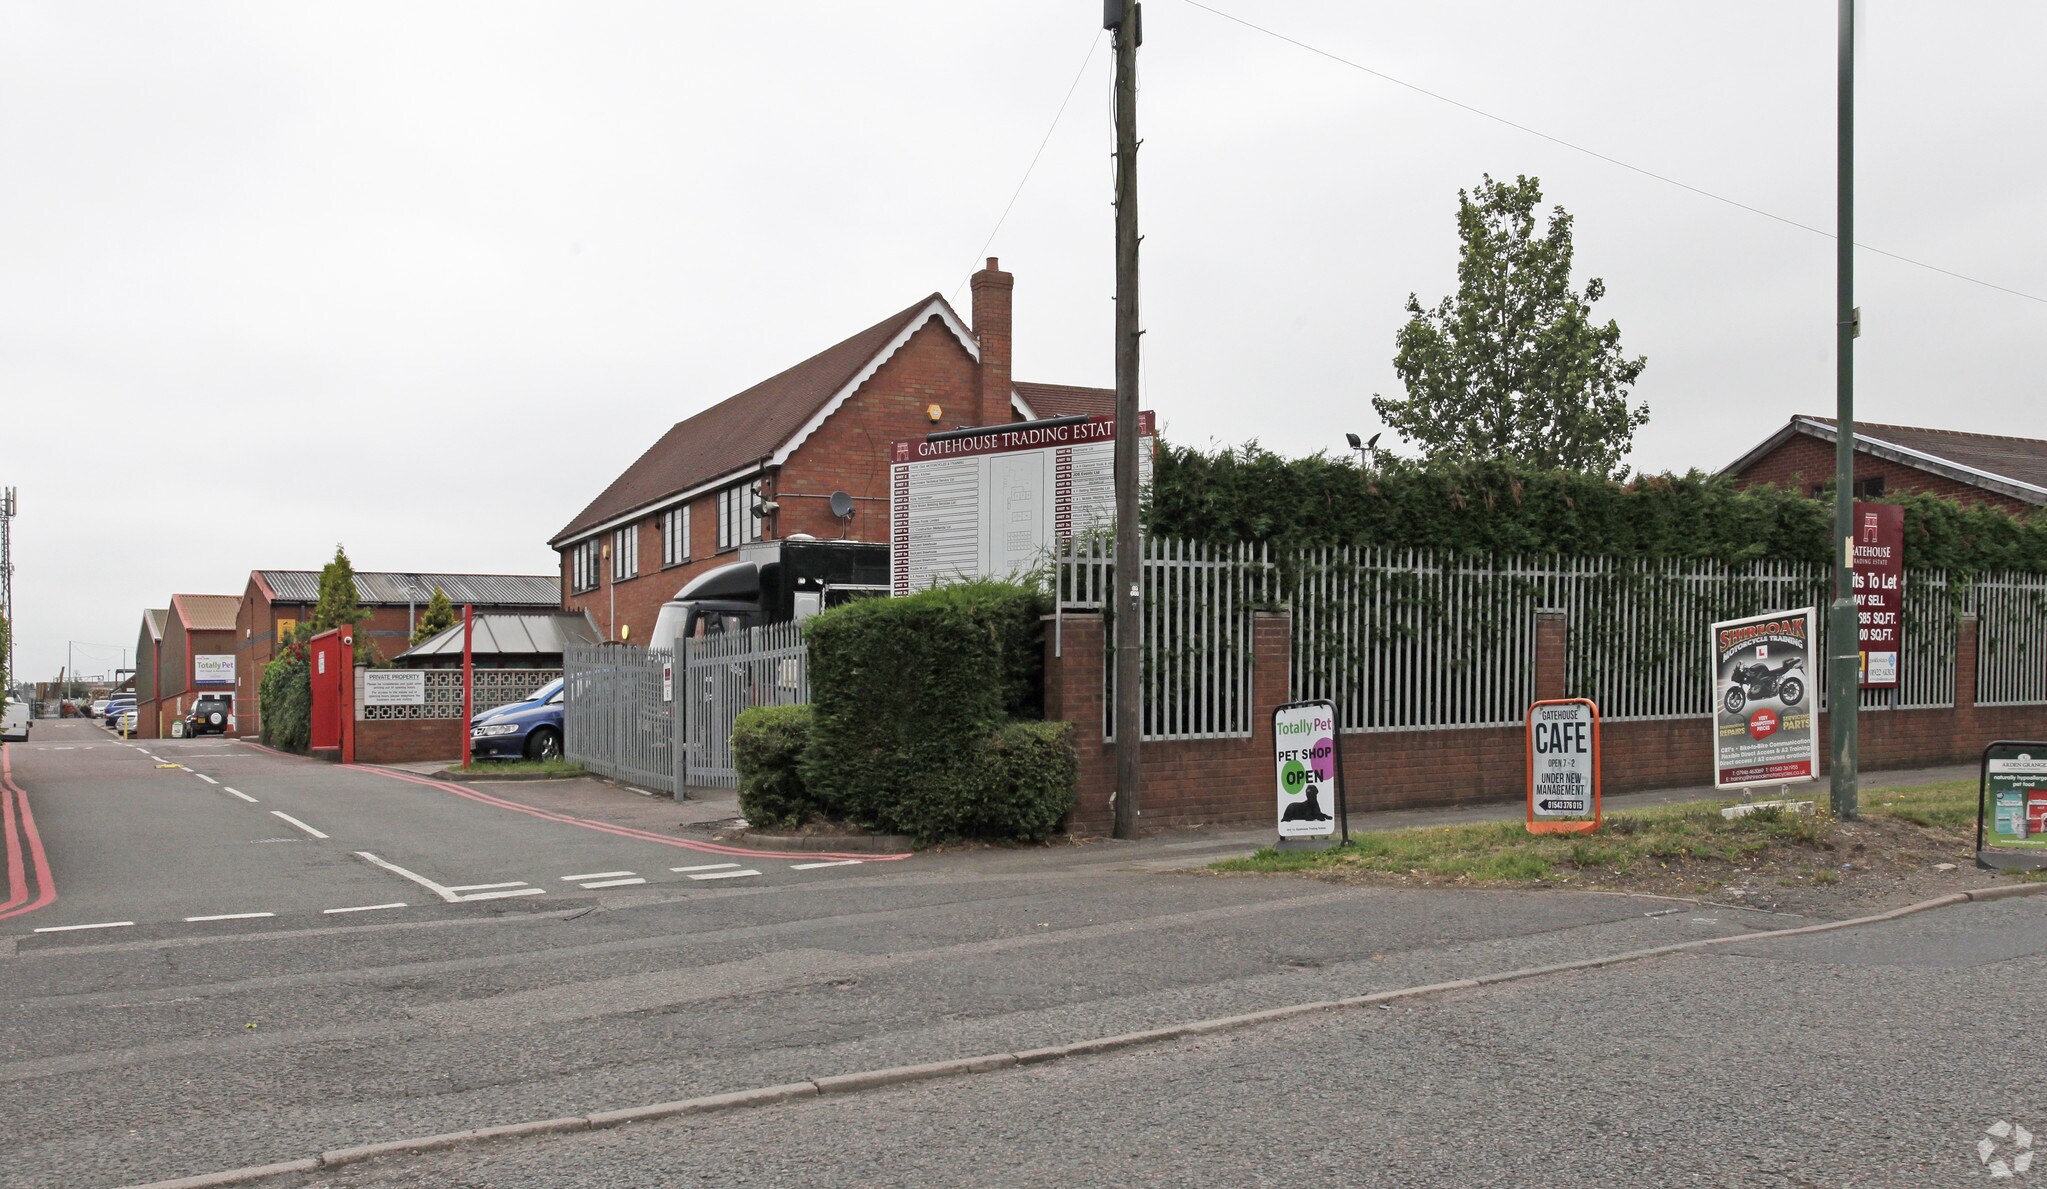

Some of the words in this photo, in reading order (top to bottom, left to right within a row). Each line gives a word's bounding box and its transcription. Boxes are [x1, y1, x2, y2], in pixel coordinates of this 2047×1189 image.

[918, 433, 998, 456] GATEHOUSE
[1001, 426, 1068, 447] TRADING
[1073, 420, 1114, 440] ESTAT
[1852, 572, 1864, 588] its
[1868, 572, 1879, 588] To
[1882, 573, 1897, 589] Let
[1868, 595, 1885, 606] SELL
[1873, 612, 1896, 624] SQ.FT.
[1720, 618, 1806, 652] SHIREOAK
[1870, 629, 1894, 641] SQ.FT.
[1722, 636, 1768, 663] MOTORCYCLE
[1769, 635, 1803, 649] TRAINING
[1542, 710, 1578, 720] GATEHOUSE
[1277, 719, 1312, 736] Totally
[1314, 718, 1332, 731] Pet
[1783, 720, 1810, 730] PARTS
[1535, 722, 1587, 754] CAFE
[1720, 728, 1745, 737] REPAIRS
[1769, 739, 1810, 747] Communication
[1279, 750, 1298, 761] PET
[1302, 747, 1332, 760] SHOP
[1548, 759, 1562, 767] OPEN
[1563, 759, 1566, 767] 7
[1571, 759, 1575, 767] 2
[1286, 769, 1324, 785] OPEN
[1541, 773, 1564, 784] UNDER
[1565, 772, 1582, 783] NEW
[1536, 784, 1584, 795] MANAGEMENT
[1548, 801, 1562, 809] 01543
[1573, 801, 1582, 809] 015
